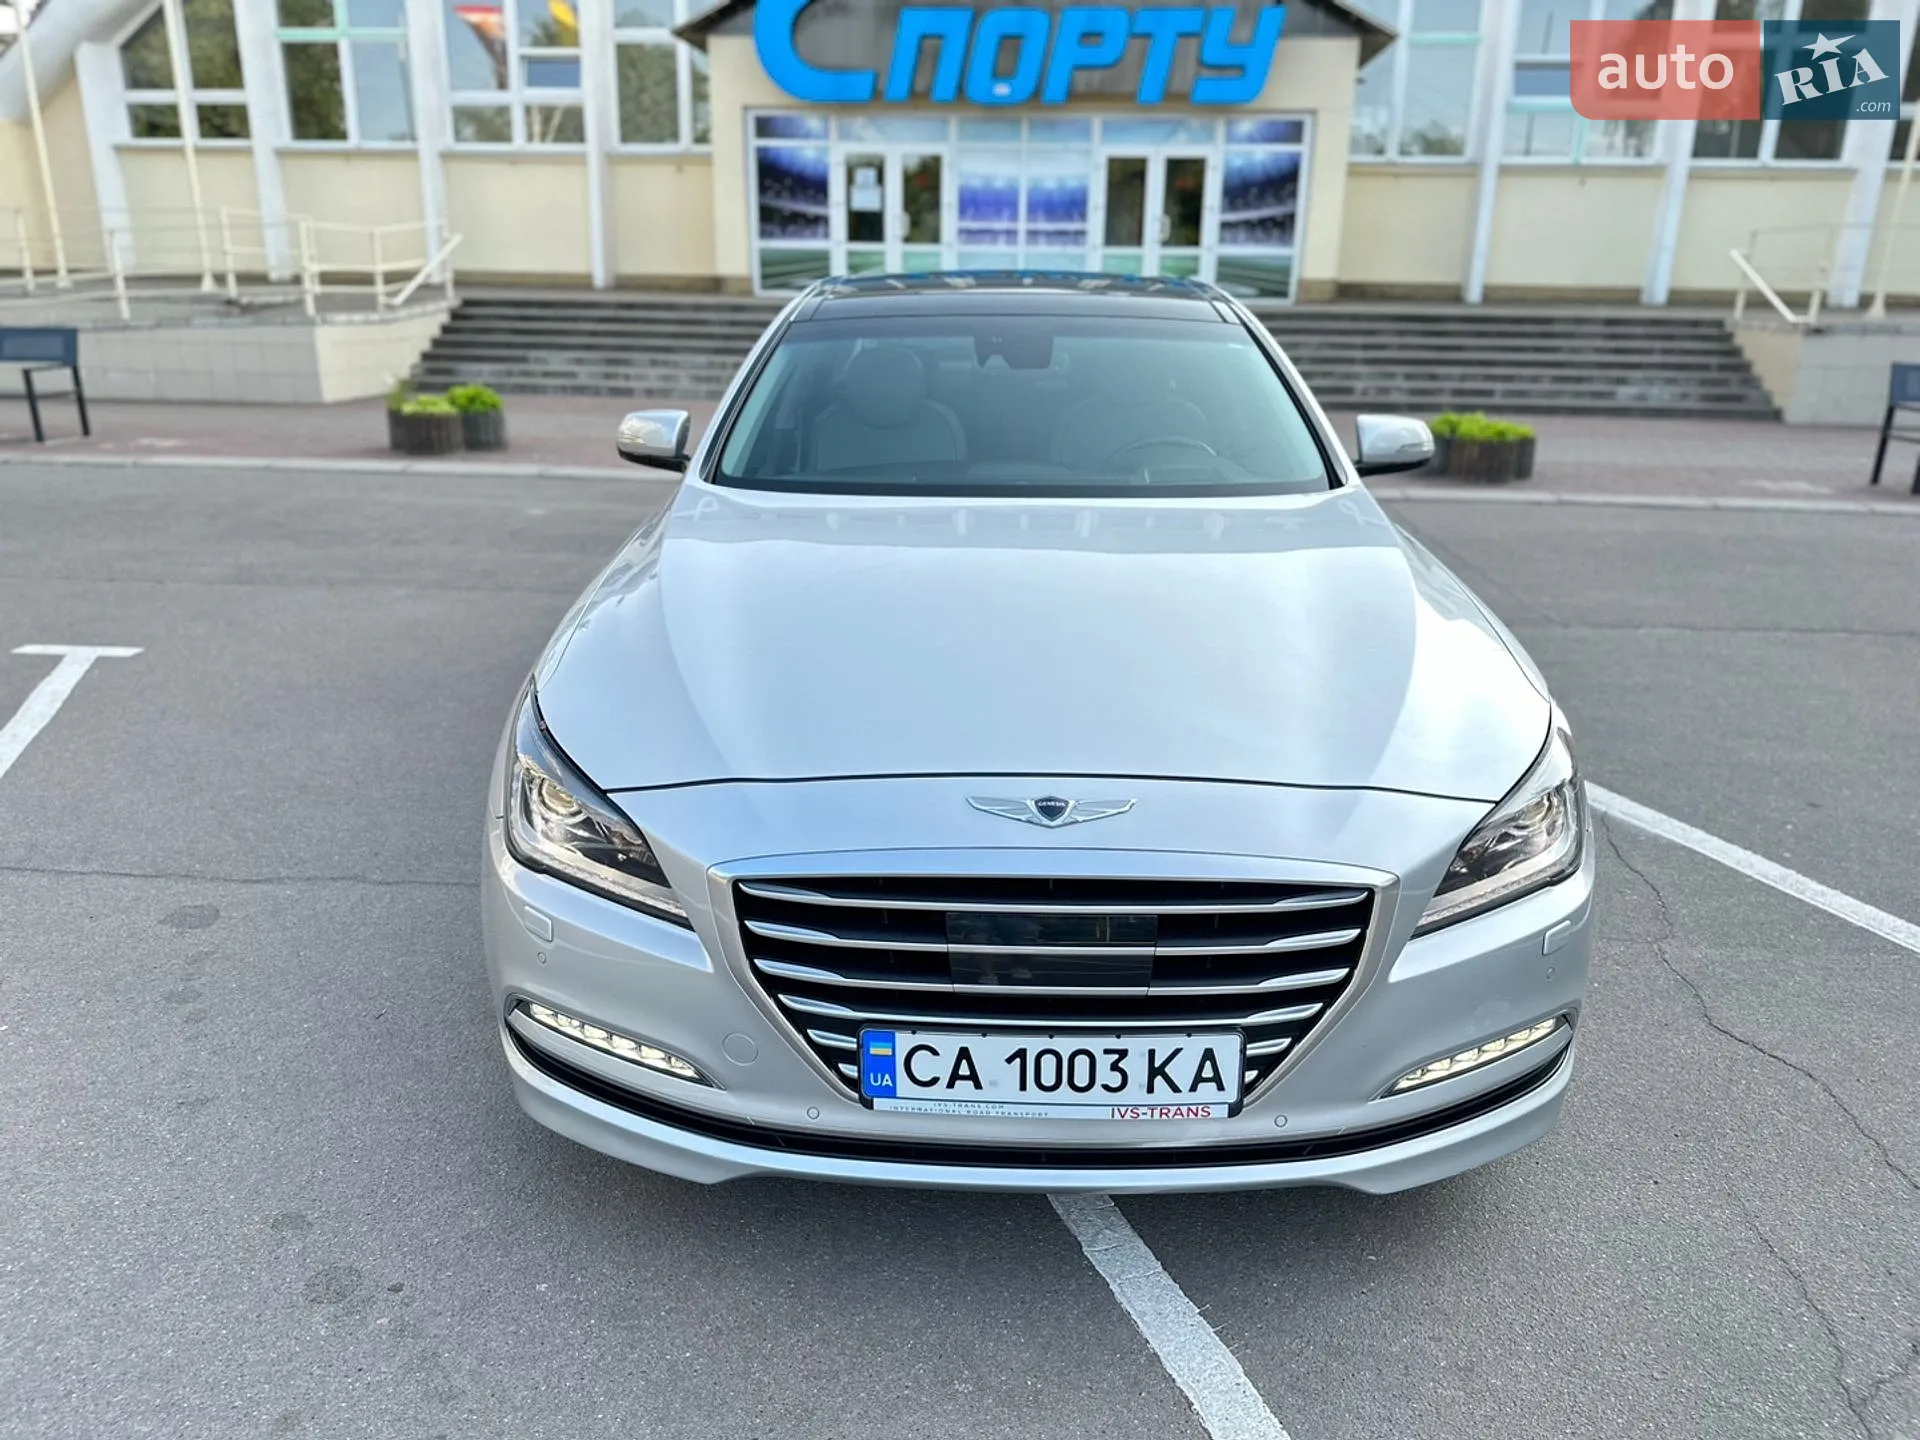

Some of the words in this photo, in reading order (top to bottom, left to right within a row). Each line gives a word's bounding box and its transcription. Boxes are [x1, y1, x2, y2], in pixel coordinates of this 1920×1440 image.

[1004, 1048, 1129, 1093] 1003
[870, 1072, 893, 1088] UA
[1111, 1106, 1211, 1119] IVS-TRANS
